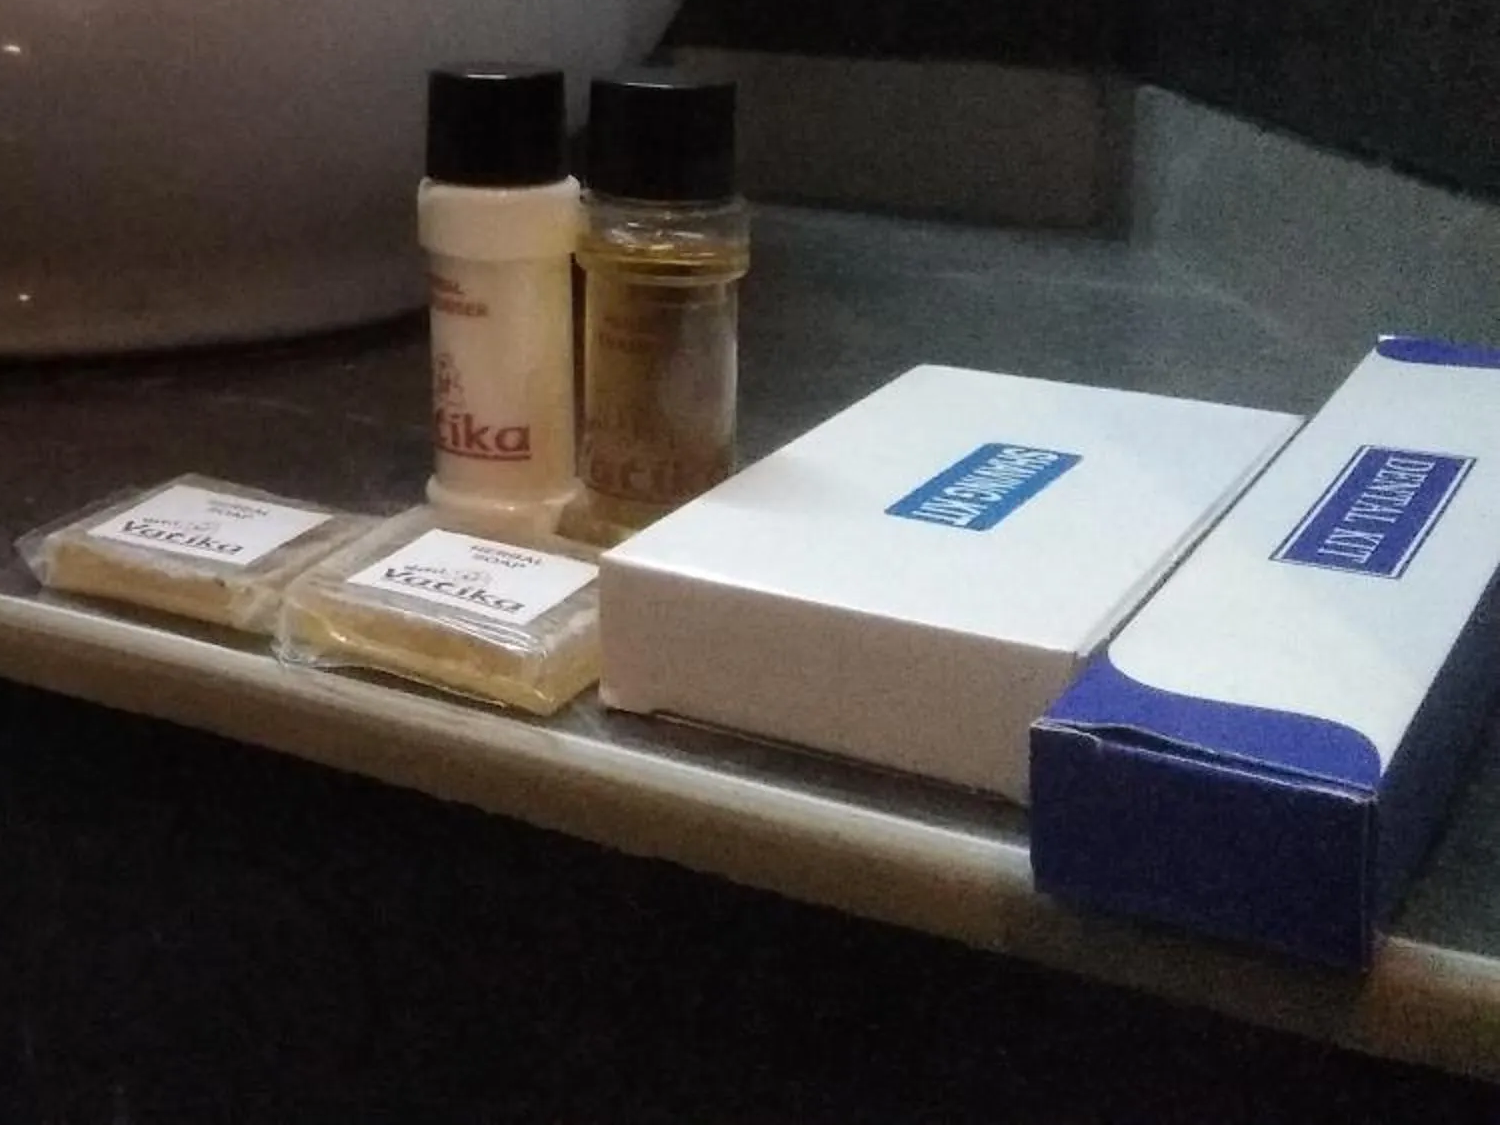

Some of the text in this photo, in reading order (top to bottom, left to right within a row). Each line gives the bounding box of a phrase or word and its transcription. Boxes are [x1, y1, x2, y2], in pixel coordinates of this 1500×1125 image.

[911, 448, 1059, 526] SHAVING KIT
[1317, 457, 1436, 564] DENTAL KIT
[122, 520, 244, 556] Vatika
[384, 567, 526, 614] Vatika
